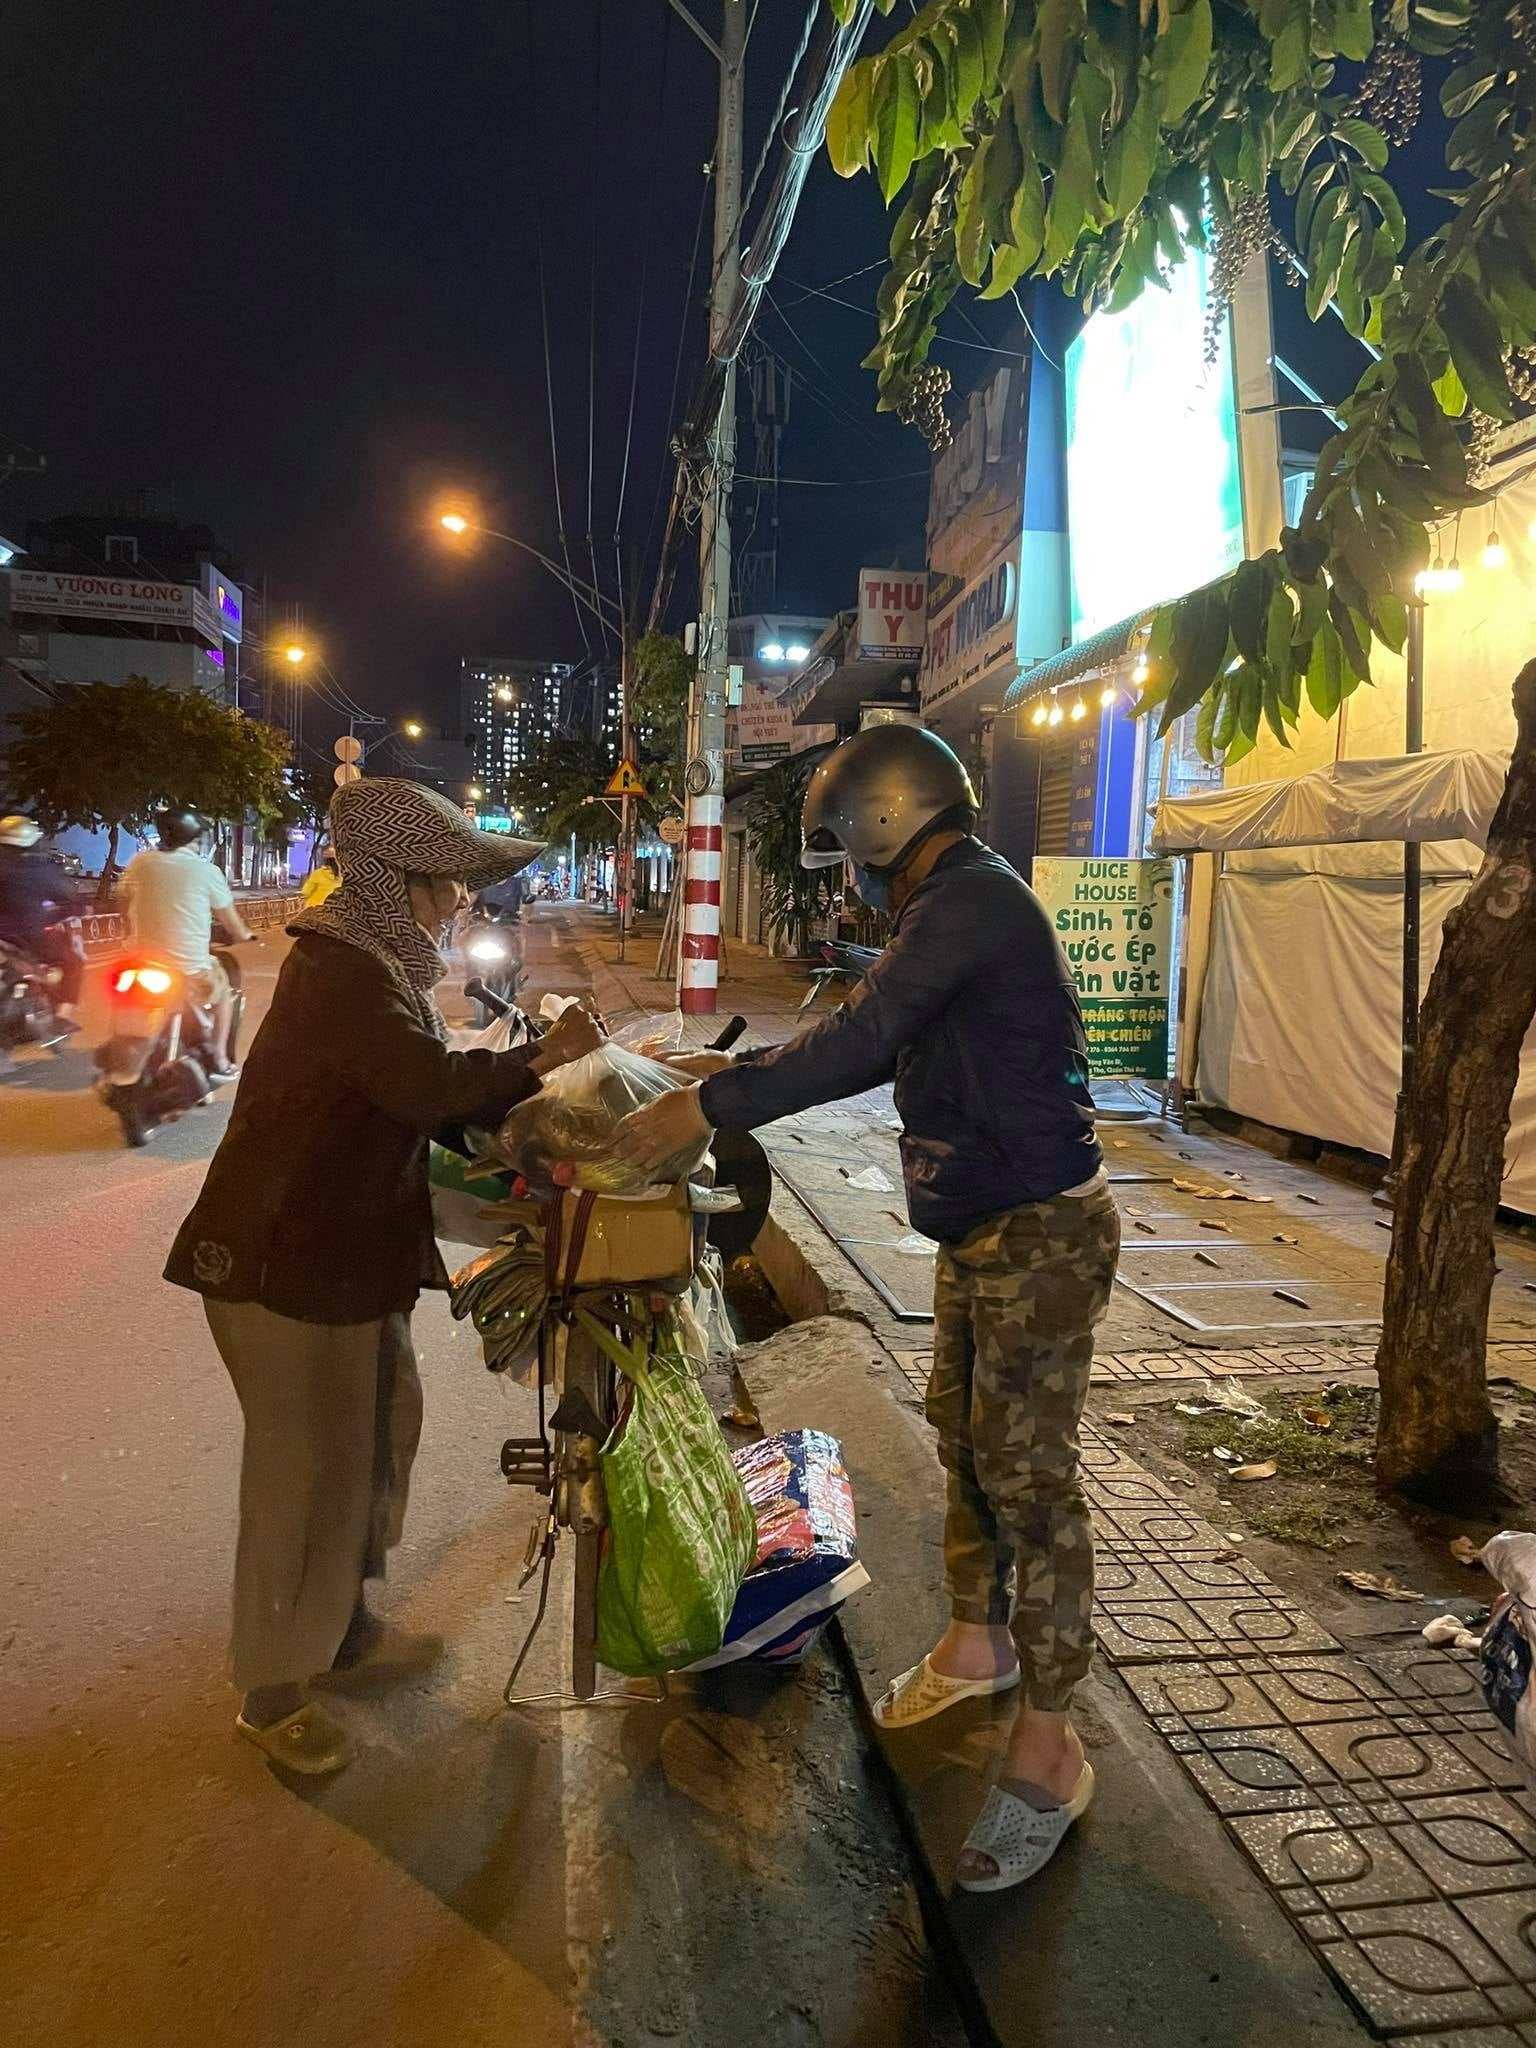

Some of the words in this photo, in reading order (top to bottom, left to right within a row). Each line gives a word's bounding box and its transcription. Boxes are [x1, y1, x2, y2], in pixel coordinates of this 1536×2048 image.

[54, 576, 123, 597] VƯƠNG
[129, 582, 184, 602] LONG
[865, 576, 924, 611] THÚ
[884, 615, 904, 643] Y
[931, 612, 954, 676] PET
[955, 560, 1016, 655] WORLD
[1079, 862, 1129, 879] JUICE
[1074, 884, 1137, 901] HOUSE
[1055, 908, 1113, 931] Sinh
[1122, 903, 1158, 931] Tố
[1126, 934, 1157, 965] Ép
[1112, 966, 1160, 997] Vặt
